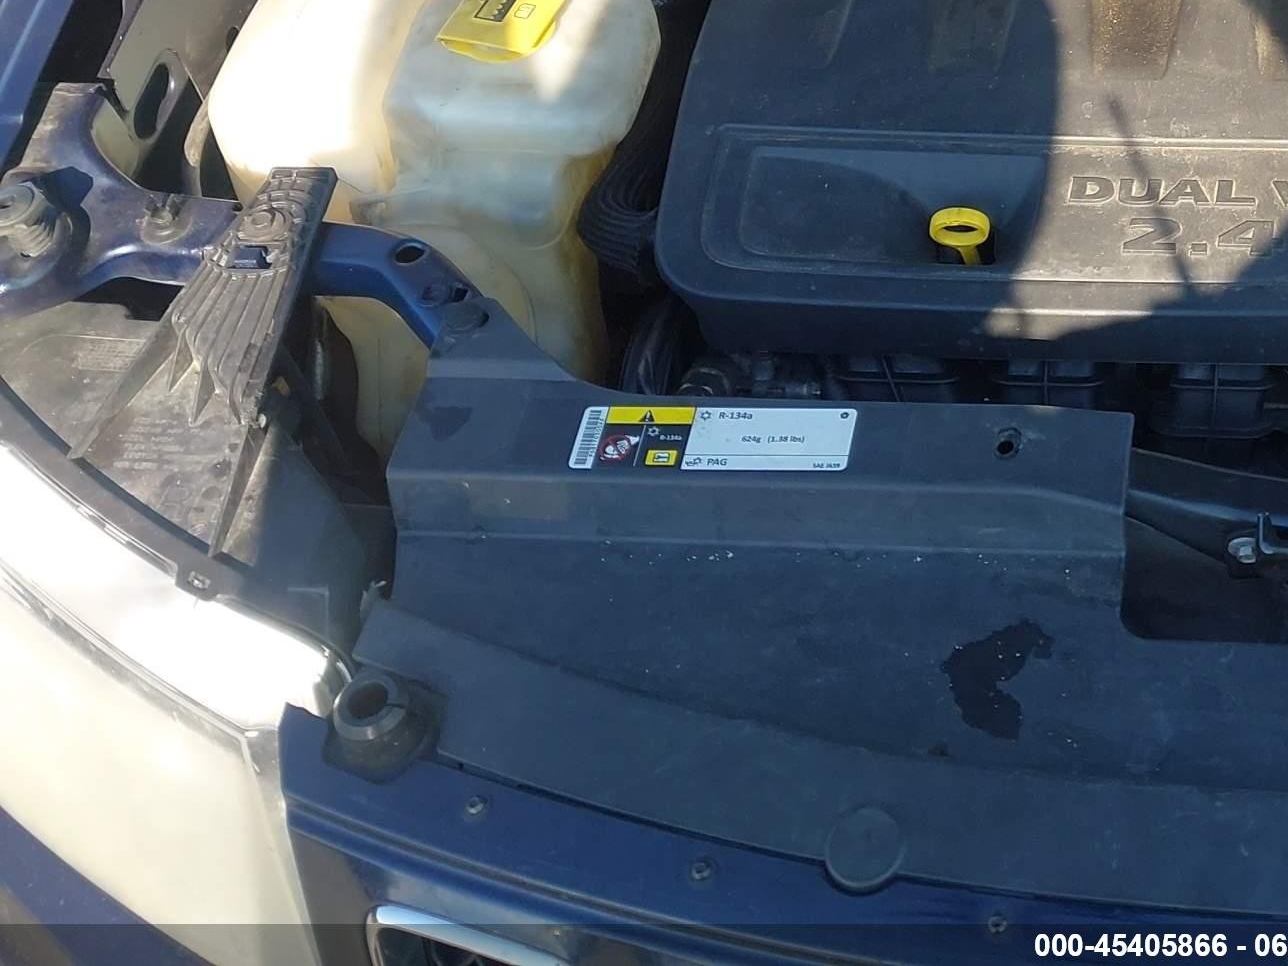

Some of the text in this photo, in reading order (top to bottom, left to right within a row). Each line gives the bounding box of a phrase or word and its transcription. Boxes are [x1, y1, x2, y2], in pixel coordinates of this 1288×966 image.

[1064, 175, 1258, 207] DUAL
[718, 411, 753, 421] R-134a
[741, 435, 805, 444] 624g (1.38 lbs)
[706, 457, 728, 467] PAG
